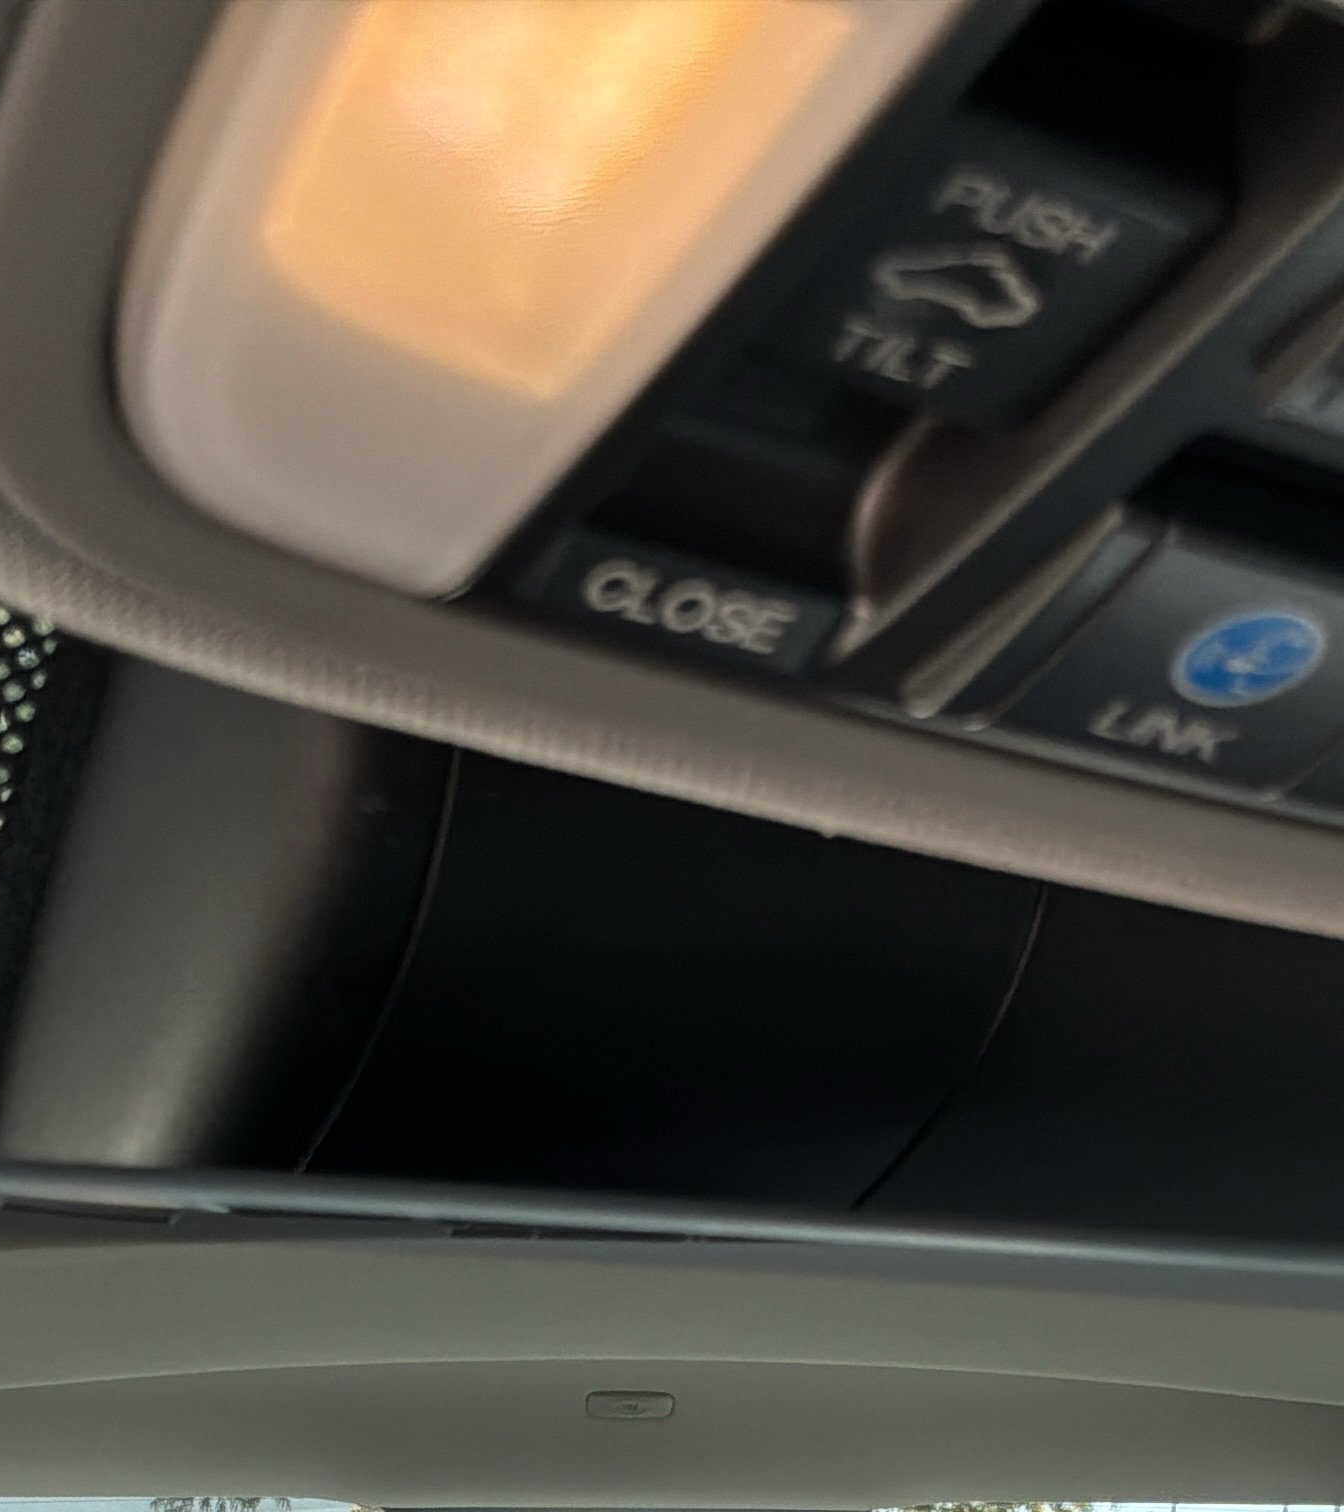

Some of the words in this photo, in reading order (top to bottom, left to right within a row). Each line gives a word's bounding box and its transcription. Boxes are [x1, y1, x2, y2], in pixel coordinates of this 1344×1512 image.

[932, 172, 1118, 264] PUSH
[833, 316, 974, 389] TILT
[584, 560, 798, 656] CLOSE
[1087, 700, 1242, 764] LINK
